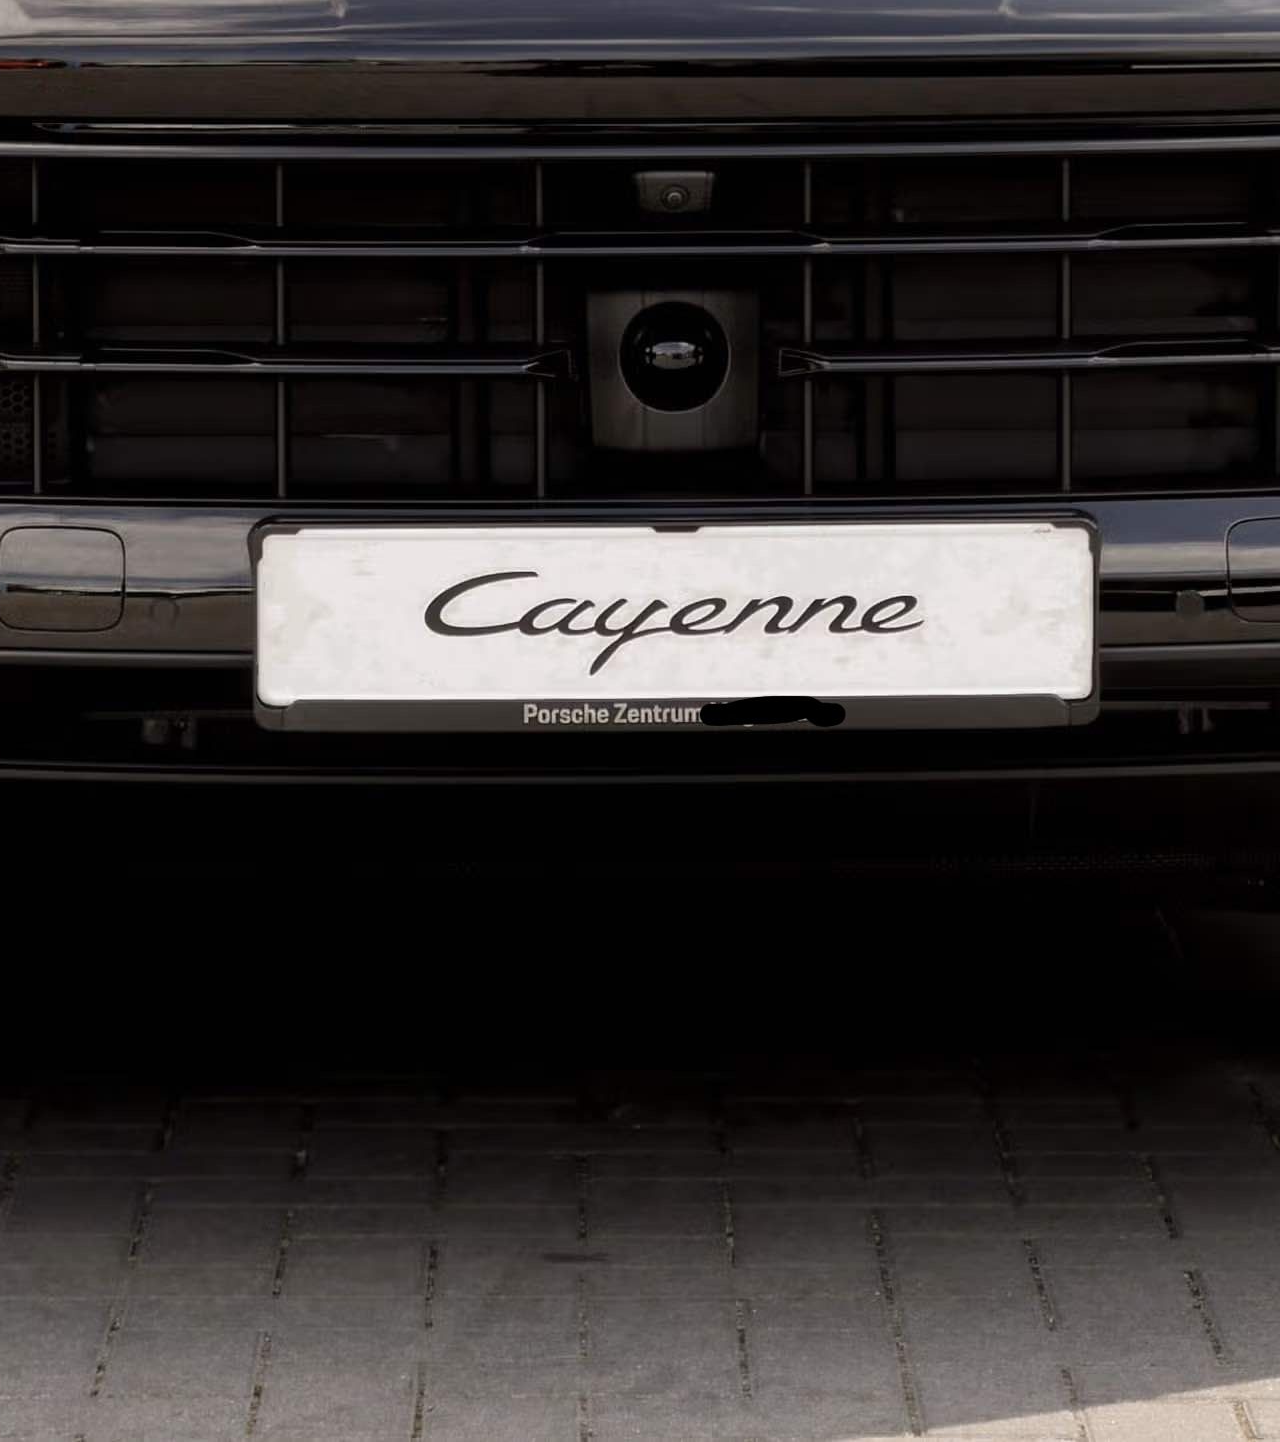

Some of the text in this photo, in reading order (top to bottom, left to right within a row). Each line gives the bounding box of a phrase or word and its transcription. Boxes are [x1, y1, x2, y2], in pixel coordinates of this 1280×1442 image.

[424, 571, 924, 676] Cayenne
[523, 704, 609, 724] Porsche
[613, 704, 703, 724] Zentrum
